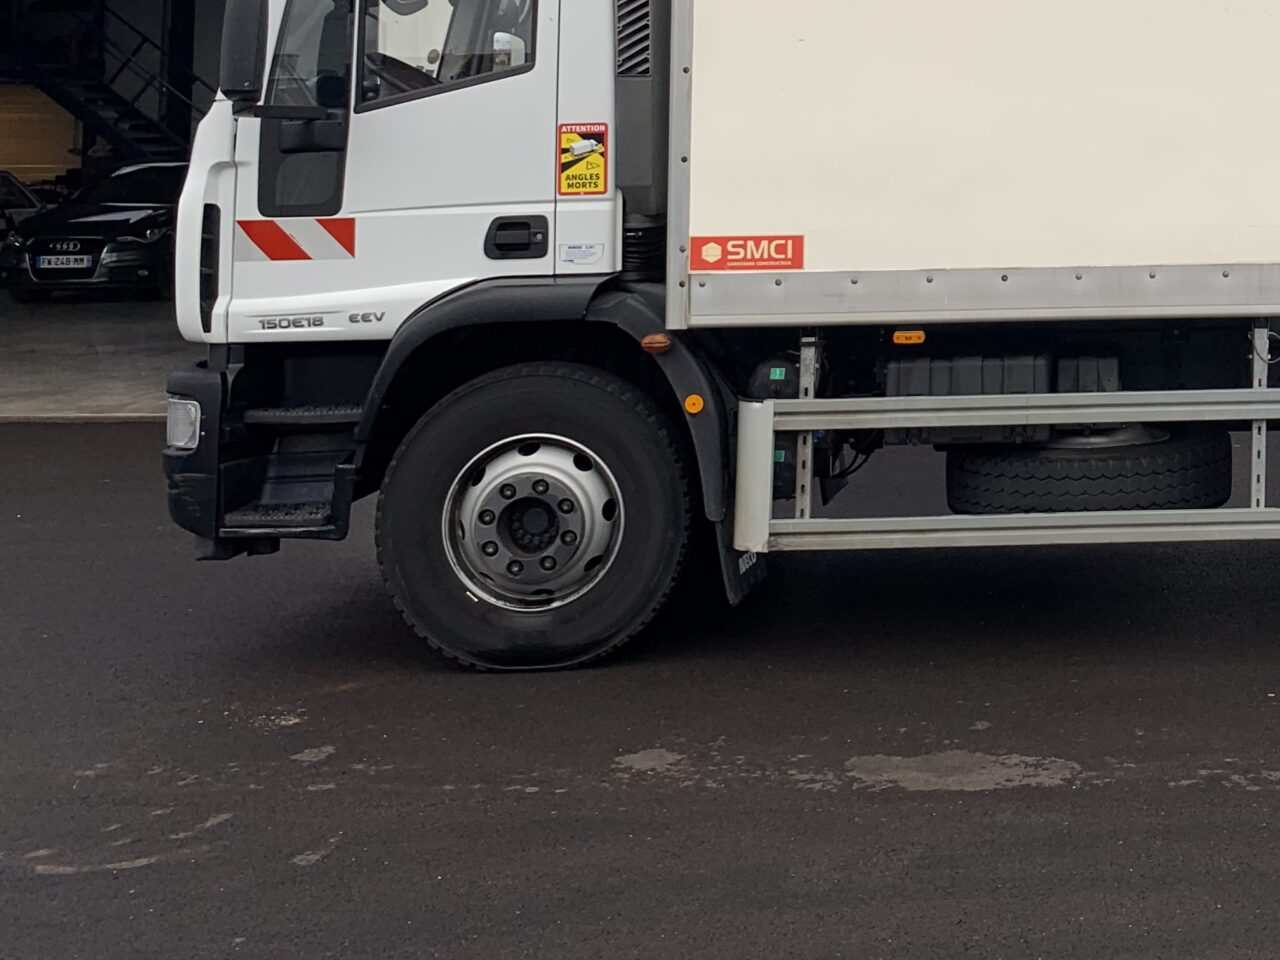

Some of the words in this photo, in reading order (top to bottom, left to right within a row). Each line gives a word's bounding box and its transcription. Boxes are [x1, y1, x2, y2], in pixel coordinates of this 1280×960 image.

[565, 173, 600, 181] ANGLES
[567, 181, 599, 190] MORTS
[726, 239, 793, 259] SMCI
[258, 316, 324, 330] 150E18
[348, 312, 385, 323] EEV
